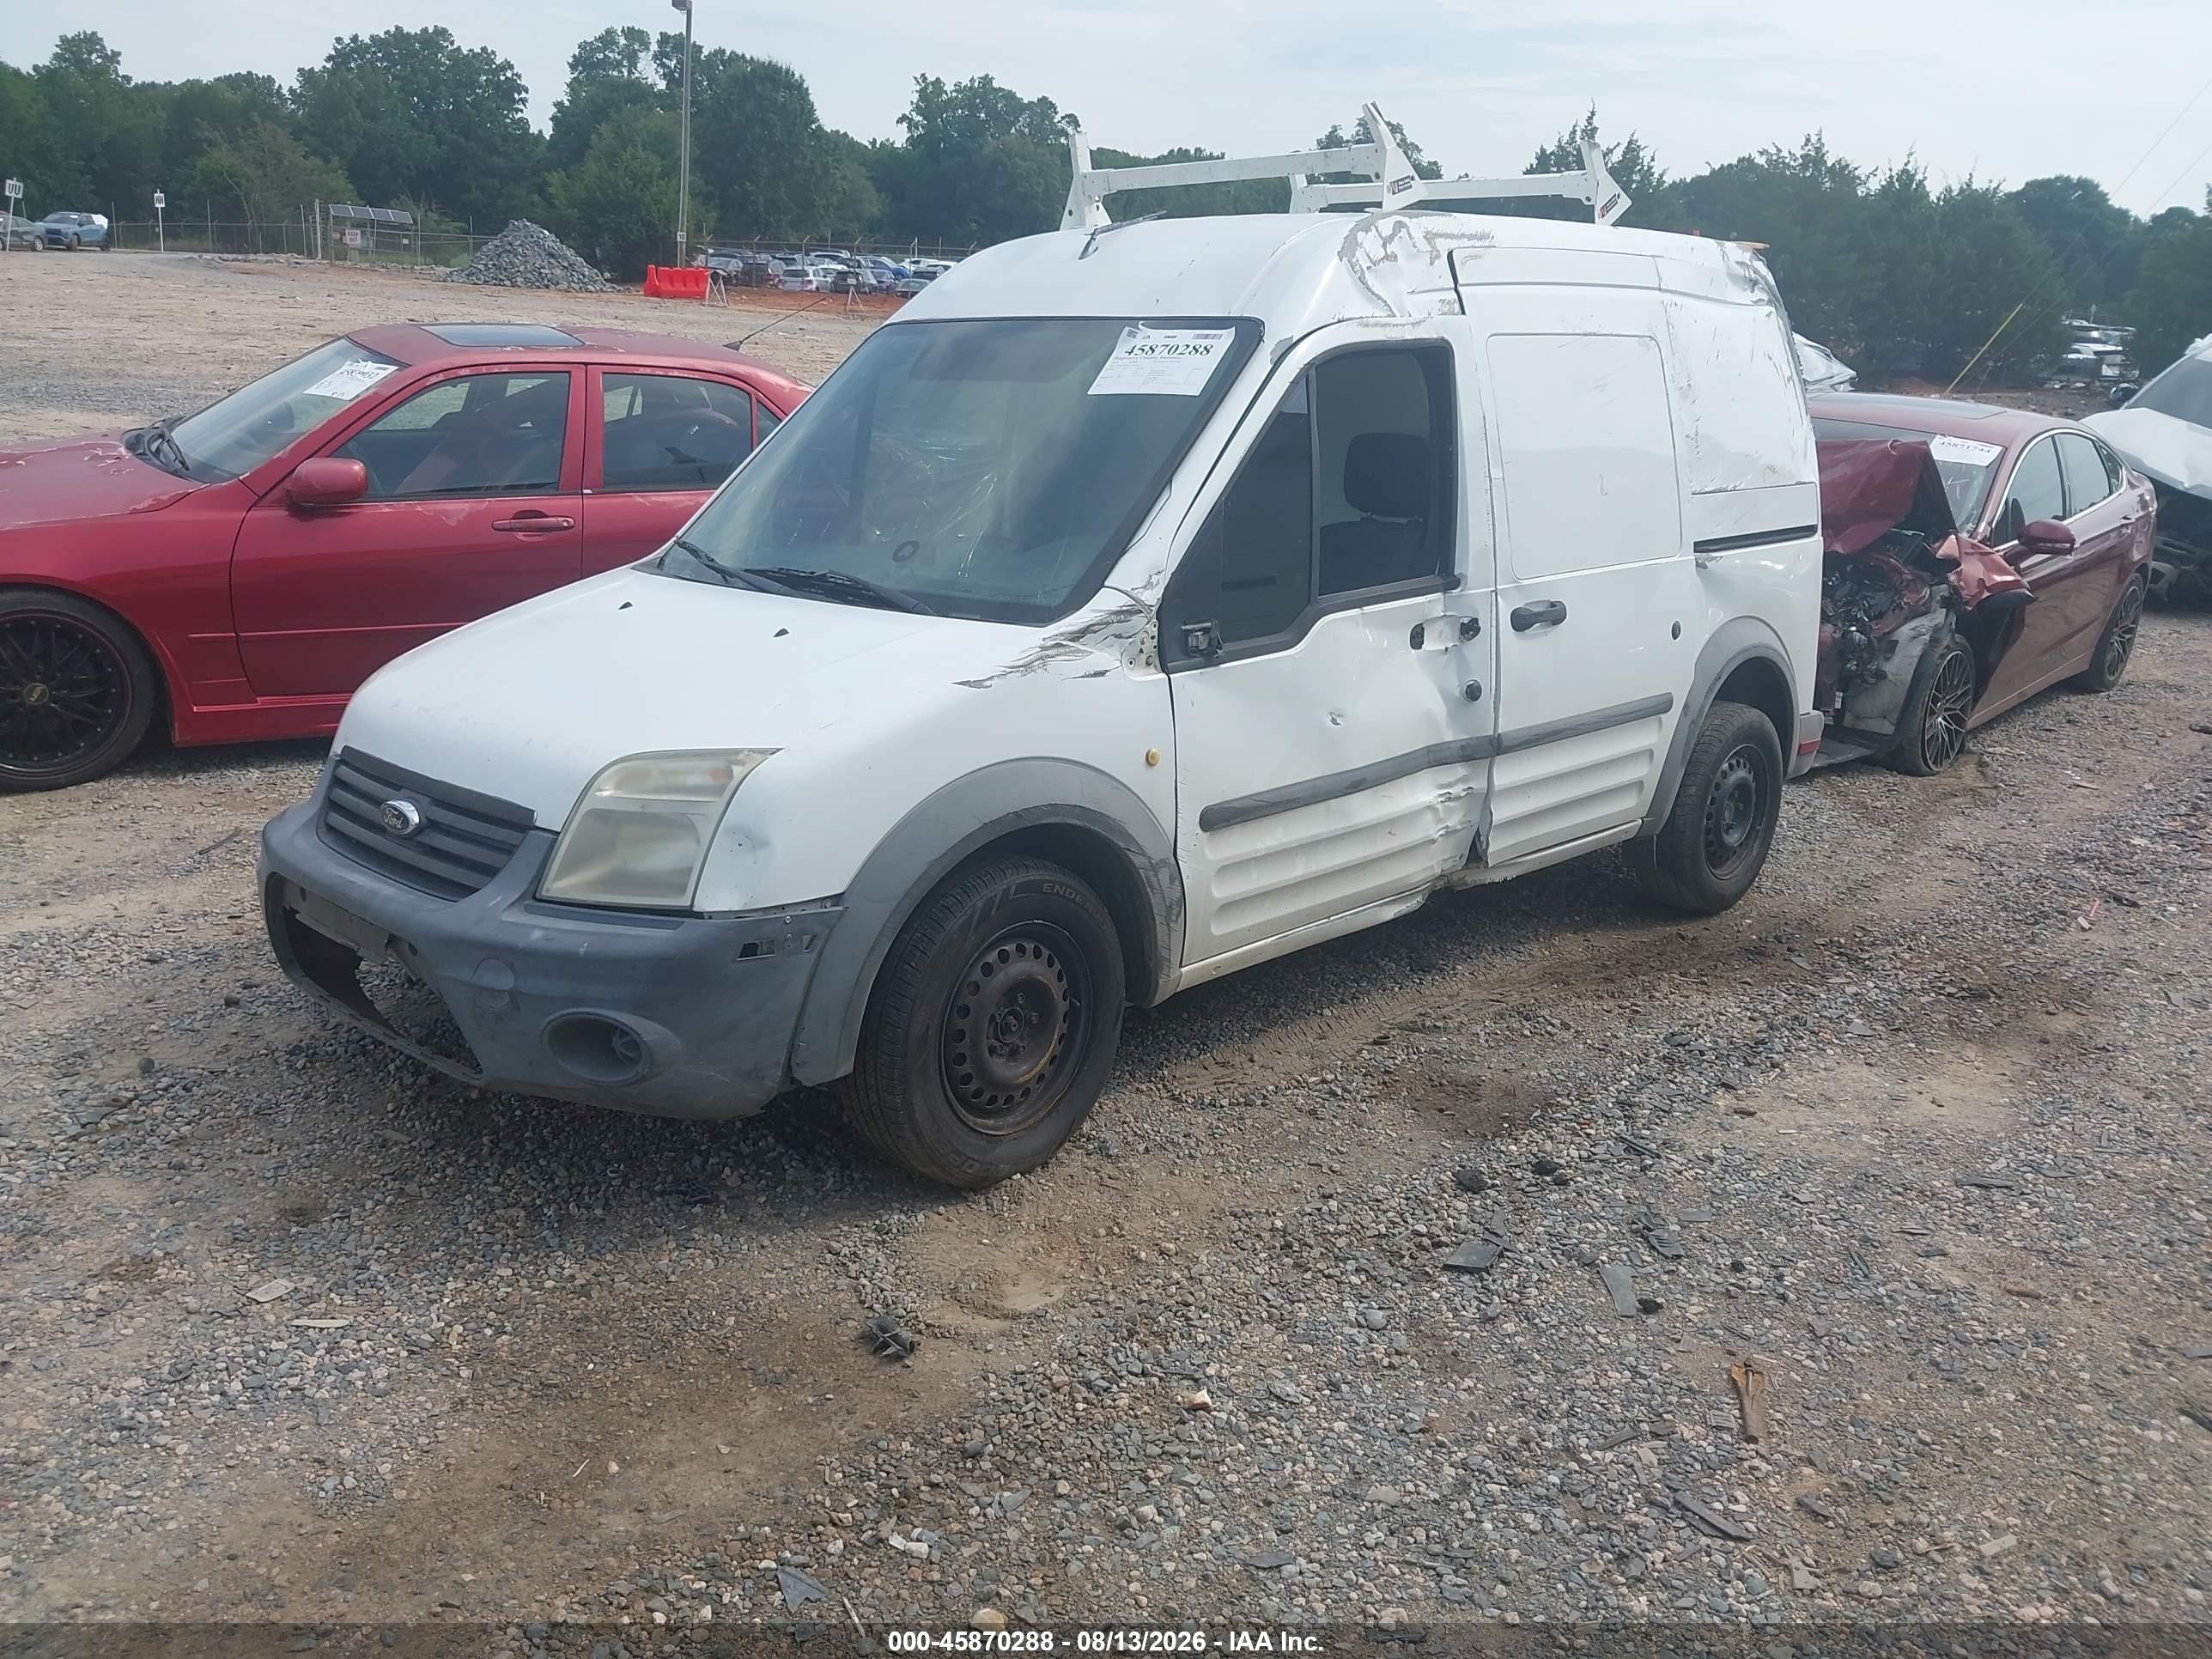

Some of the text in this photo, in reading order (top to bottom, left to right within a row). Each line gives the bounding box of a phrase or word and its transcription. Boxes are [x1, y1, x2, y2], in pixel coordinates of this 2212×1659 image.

[9, 183, 21, 196] UU
[1125, 343, 1213, 356] 45870288
[384, 807, 404, 829] Ford
